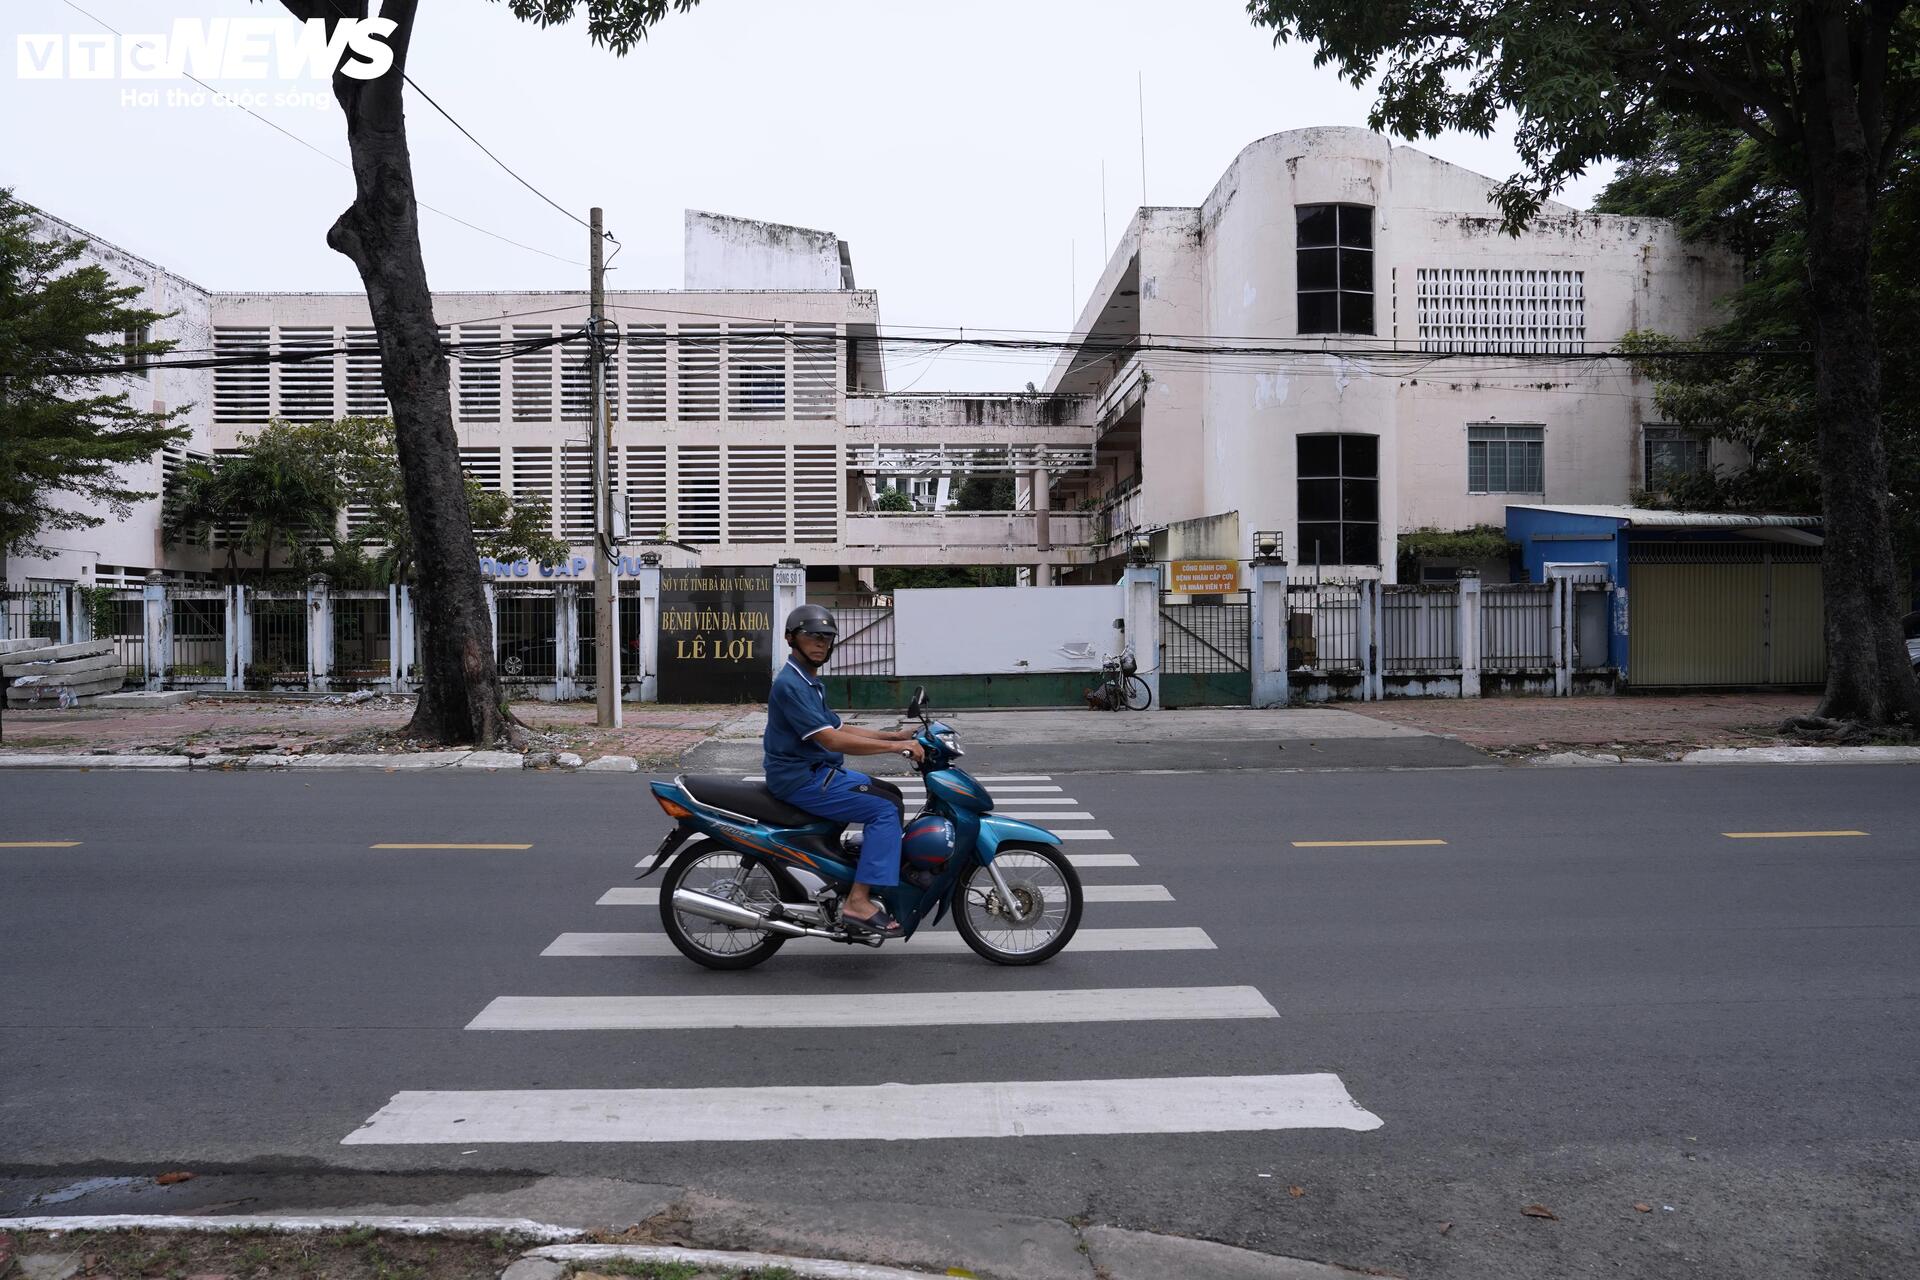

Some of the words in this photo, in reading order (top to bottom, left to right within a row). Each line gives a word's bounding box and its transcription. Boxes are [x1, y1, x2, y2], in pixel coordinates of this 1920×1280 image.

[662, 573, 672, 591] SỞ
[673, 579, 679, 591] Y
[680, 572, 689, 591] TẾ
[690, 574, 708, 591] TỈNH
[709, 574, 718, 591] BÀ
[720, 578, 733, 593] RỊA
[735, 575, 754, 591] VŨNG
[755, 574, 770, 591] TÀU
[1205, 583, 1218, 591] VIÊN
[1223, 582, 1231, 590] TẾ
[1209, 572, 1221, 580] CẤP
[662, 606, 691, 634] BỆNH
[694, 606, 720, 634] VIỆN
[722, 612, 739, 631] ĐA
[740, 612, 770, 631] KHOA
[676, 635, 706, 659] LÊ
[714, 637, 754, 663] LỢI
